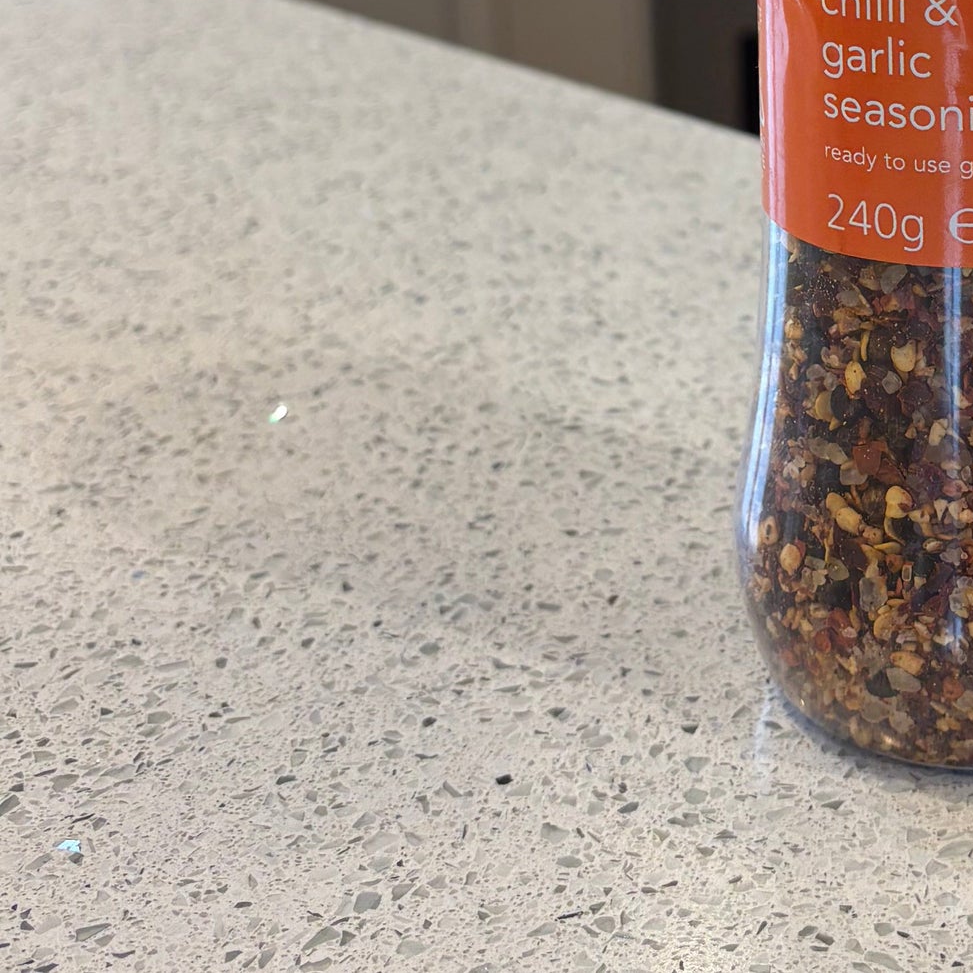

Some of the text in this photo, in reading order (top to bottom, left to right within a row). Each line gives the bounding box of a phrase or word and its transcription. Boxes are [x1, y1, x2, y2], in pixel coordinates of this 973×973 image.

[821, 37, 932, 80] garlic
[825, 145, 876, 173] ready
[884, 154, 906, 172] to
[914, 157, 951, 174] use
[826, 193, 925, 253] 240g
